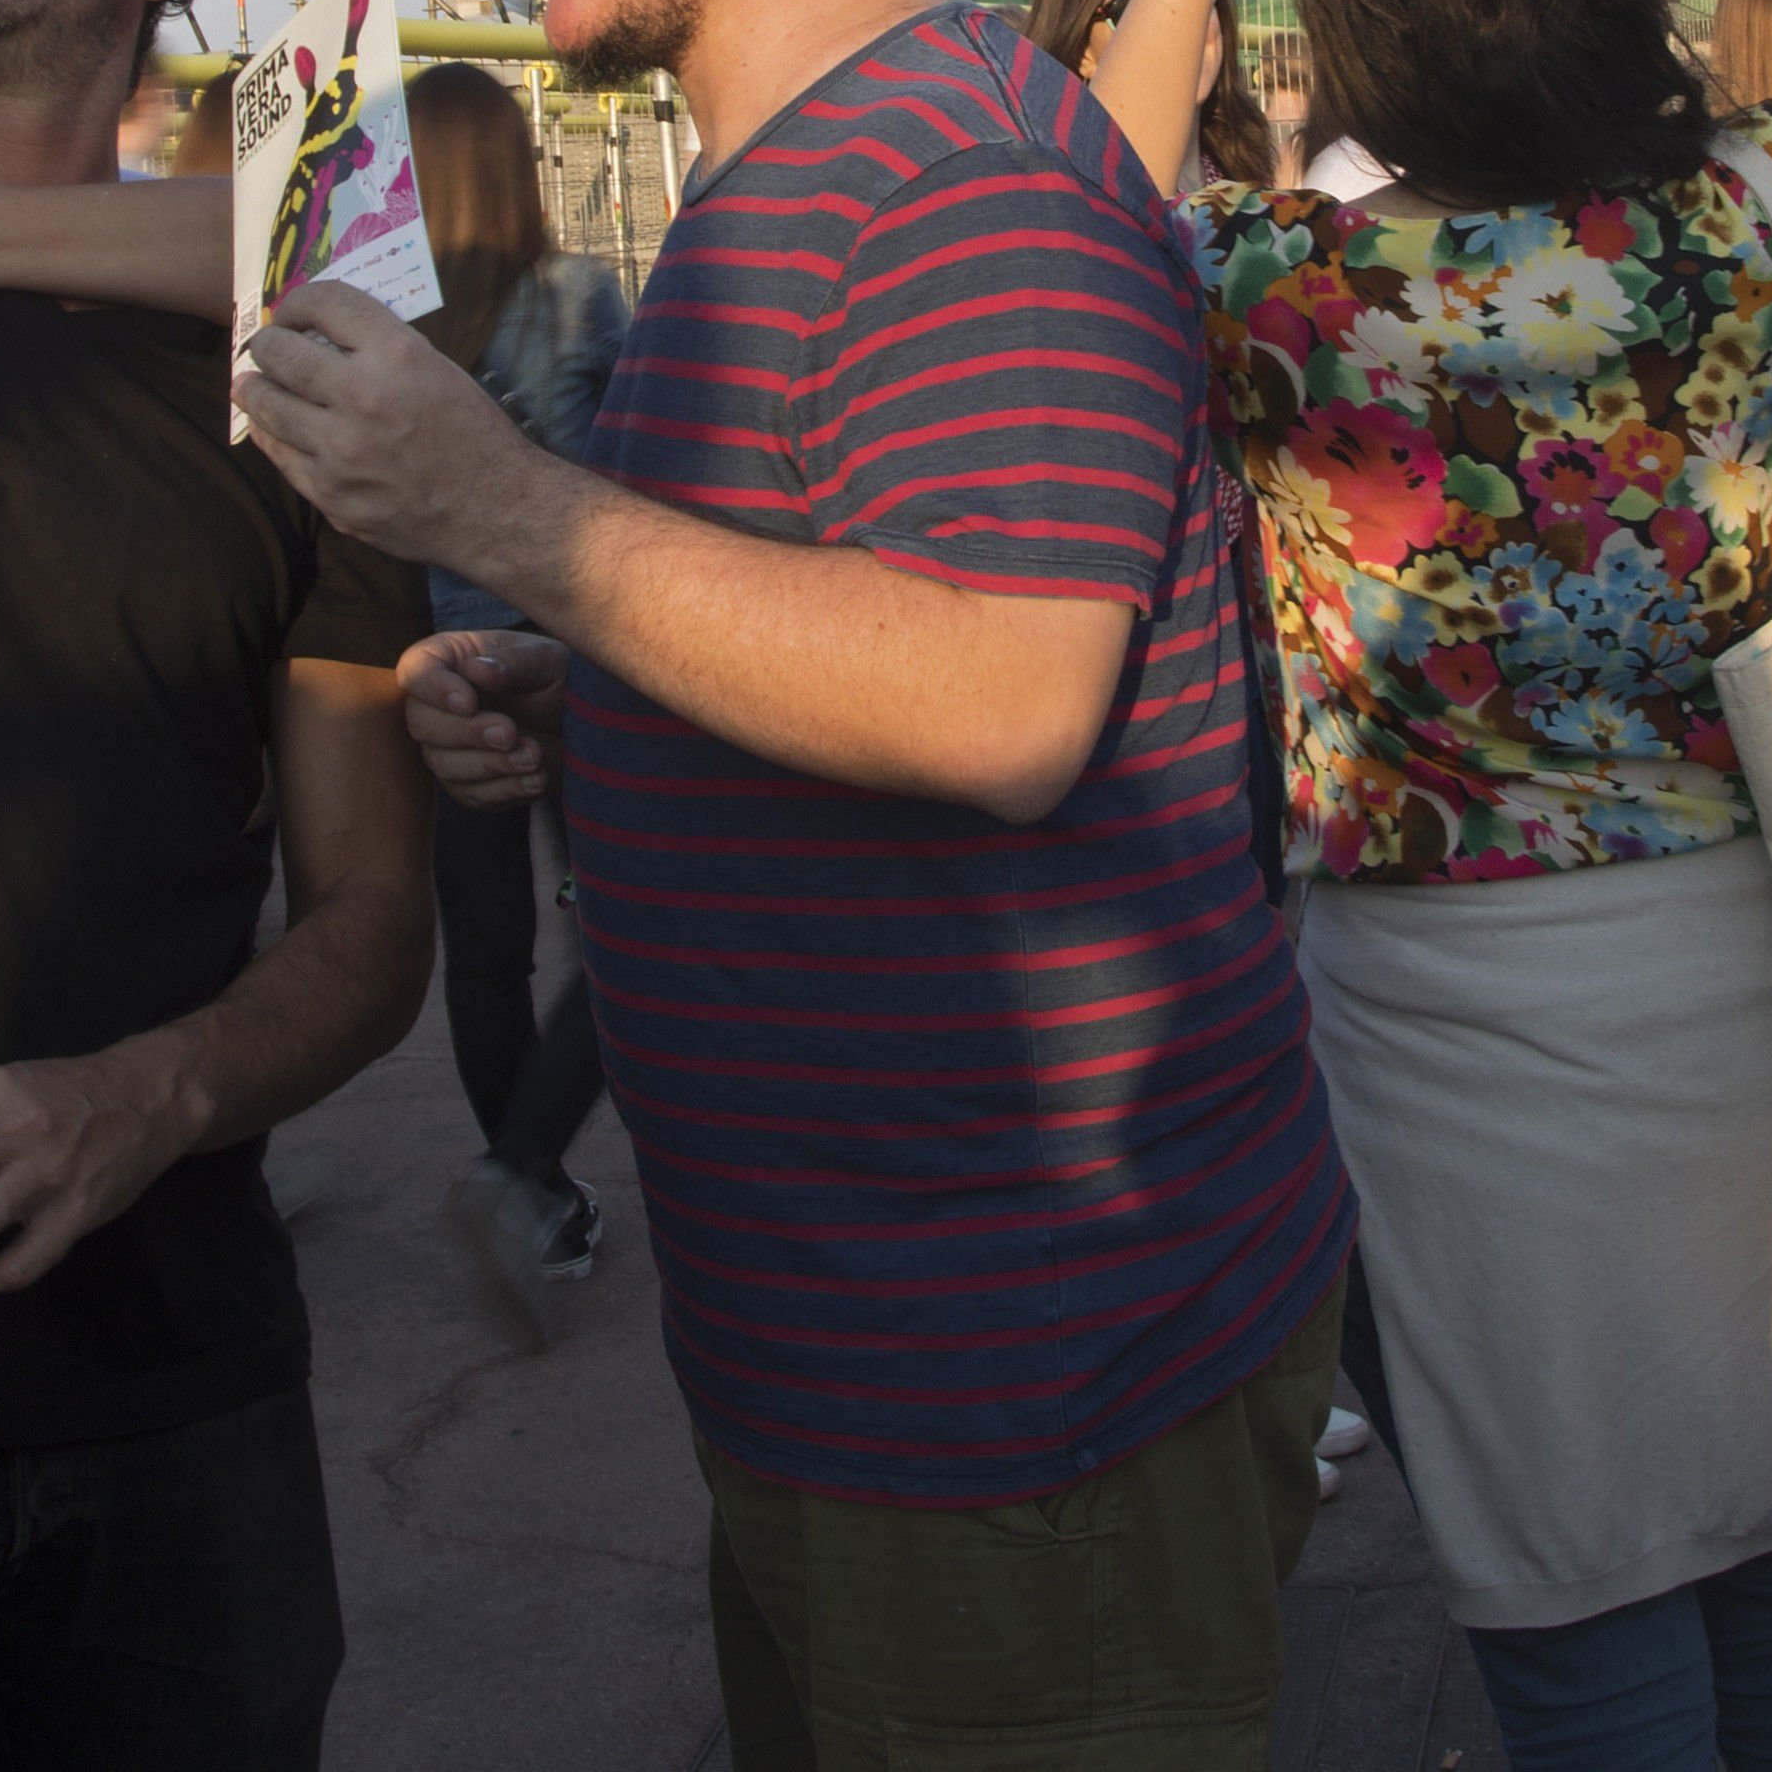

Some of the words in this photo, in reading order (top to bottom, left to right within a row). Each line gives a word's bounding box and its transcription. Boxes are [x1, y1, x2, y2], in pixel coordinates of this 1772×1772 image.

[236, 48, 289, 117] PRIMA
[237, 80, 282, 136] VERA
[238, 93, 292, 161] SOUND
